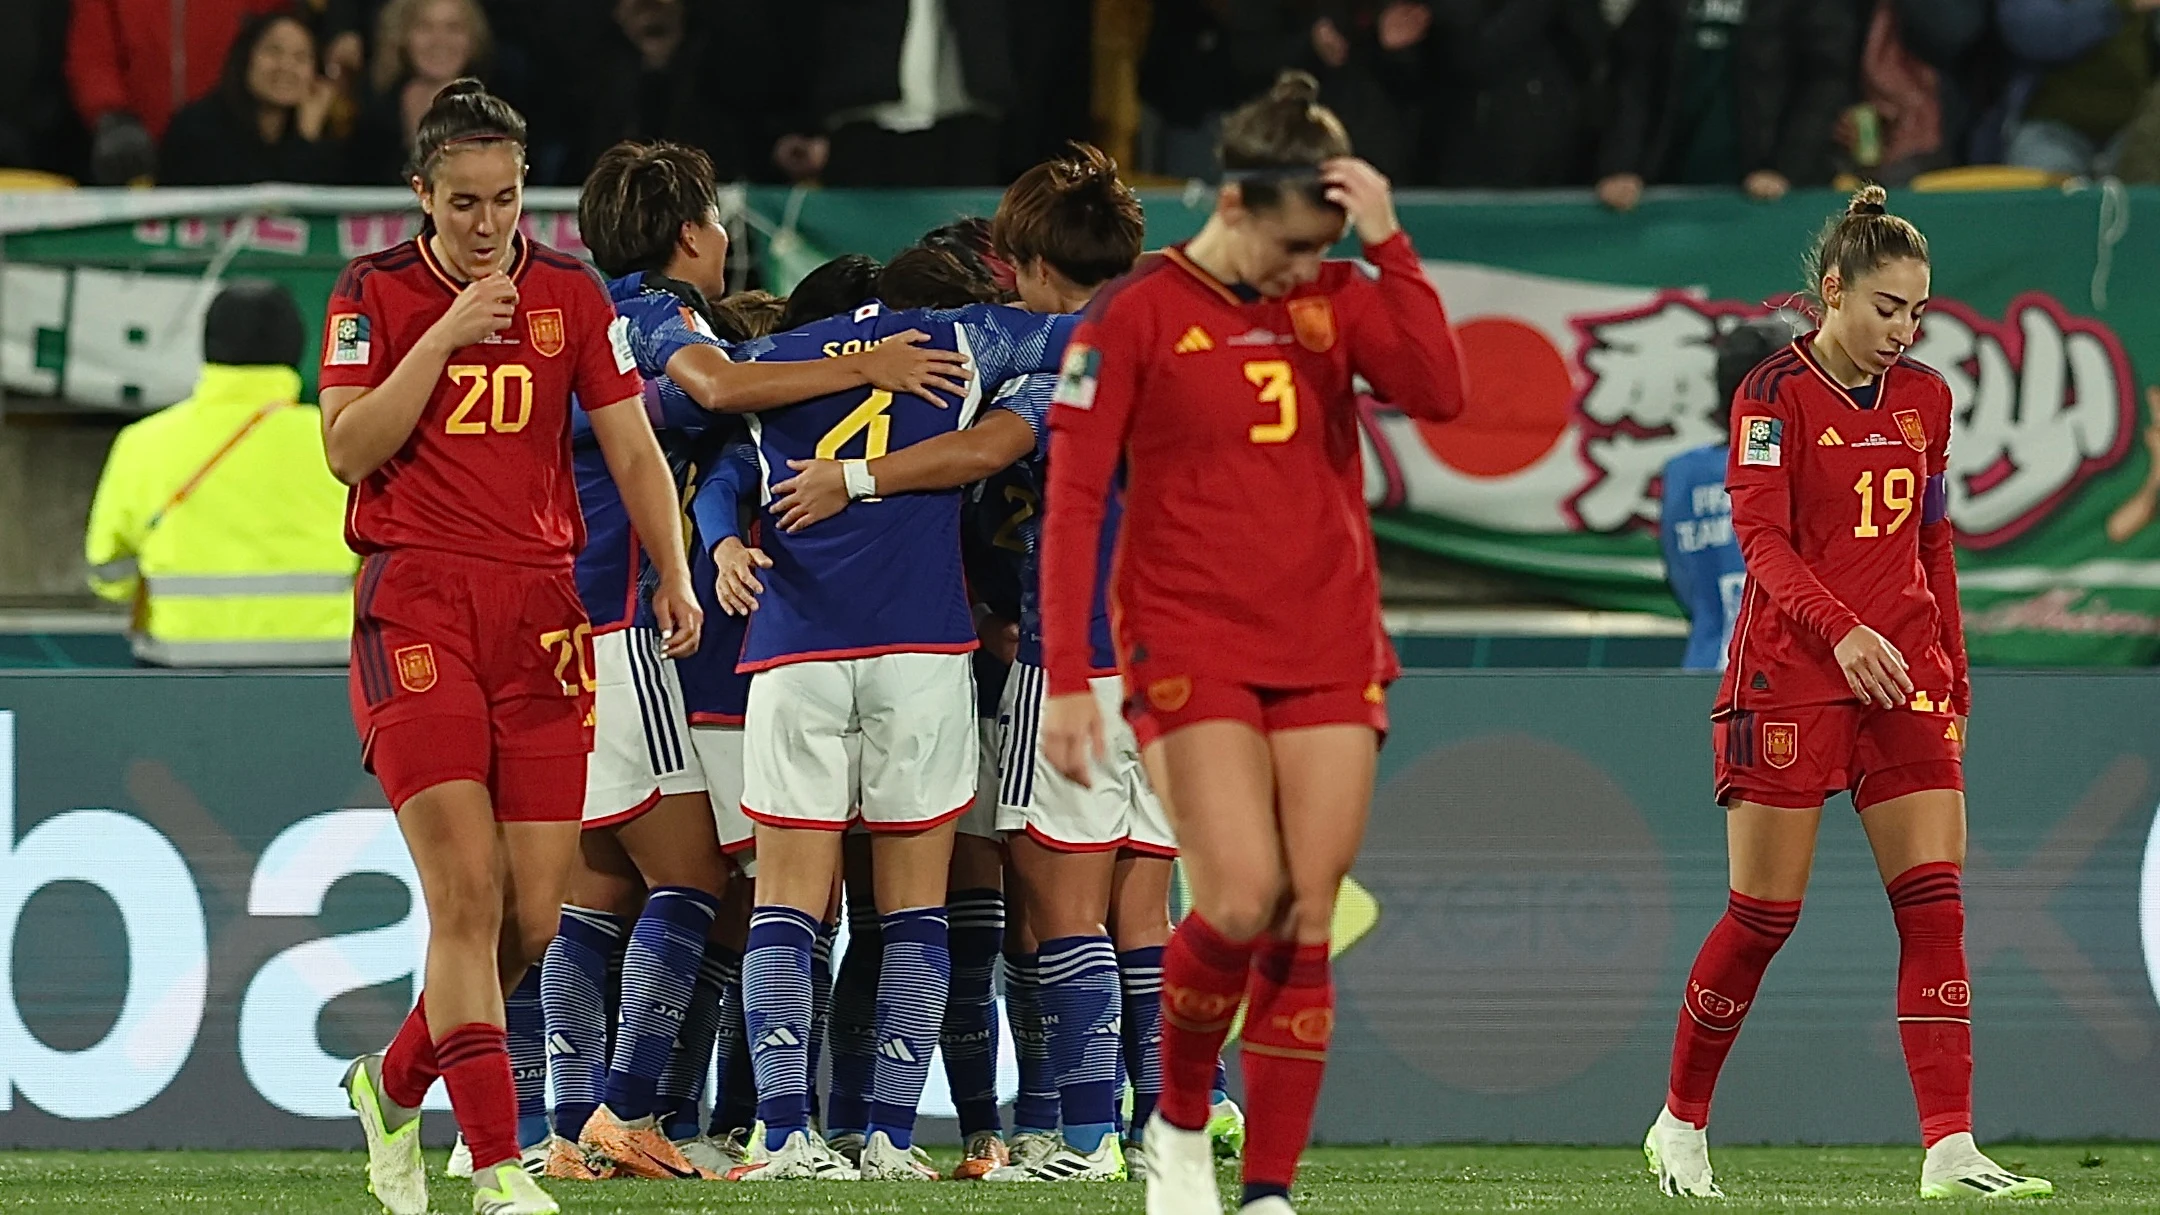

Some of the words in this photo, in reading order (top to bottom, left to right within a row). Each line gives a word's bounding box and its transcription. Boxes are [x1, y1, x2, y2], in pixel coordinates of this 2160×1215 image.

[445, 364, 533, 434] 20
[1243, 359, 1298, 444] 3
[815, 388, 893, 502] 4
[1853, 468, 1915, 538] 19
[653, 1004, 686, 1022] JAP
[513, 1068, 547, 1080] JAP
